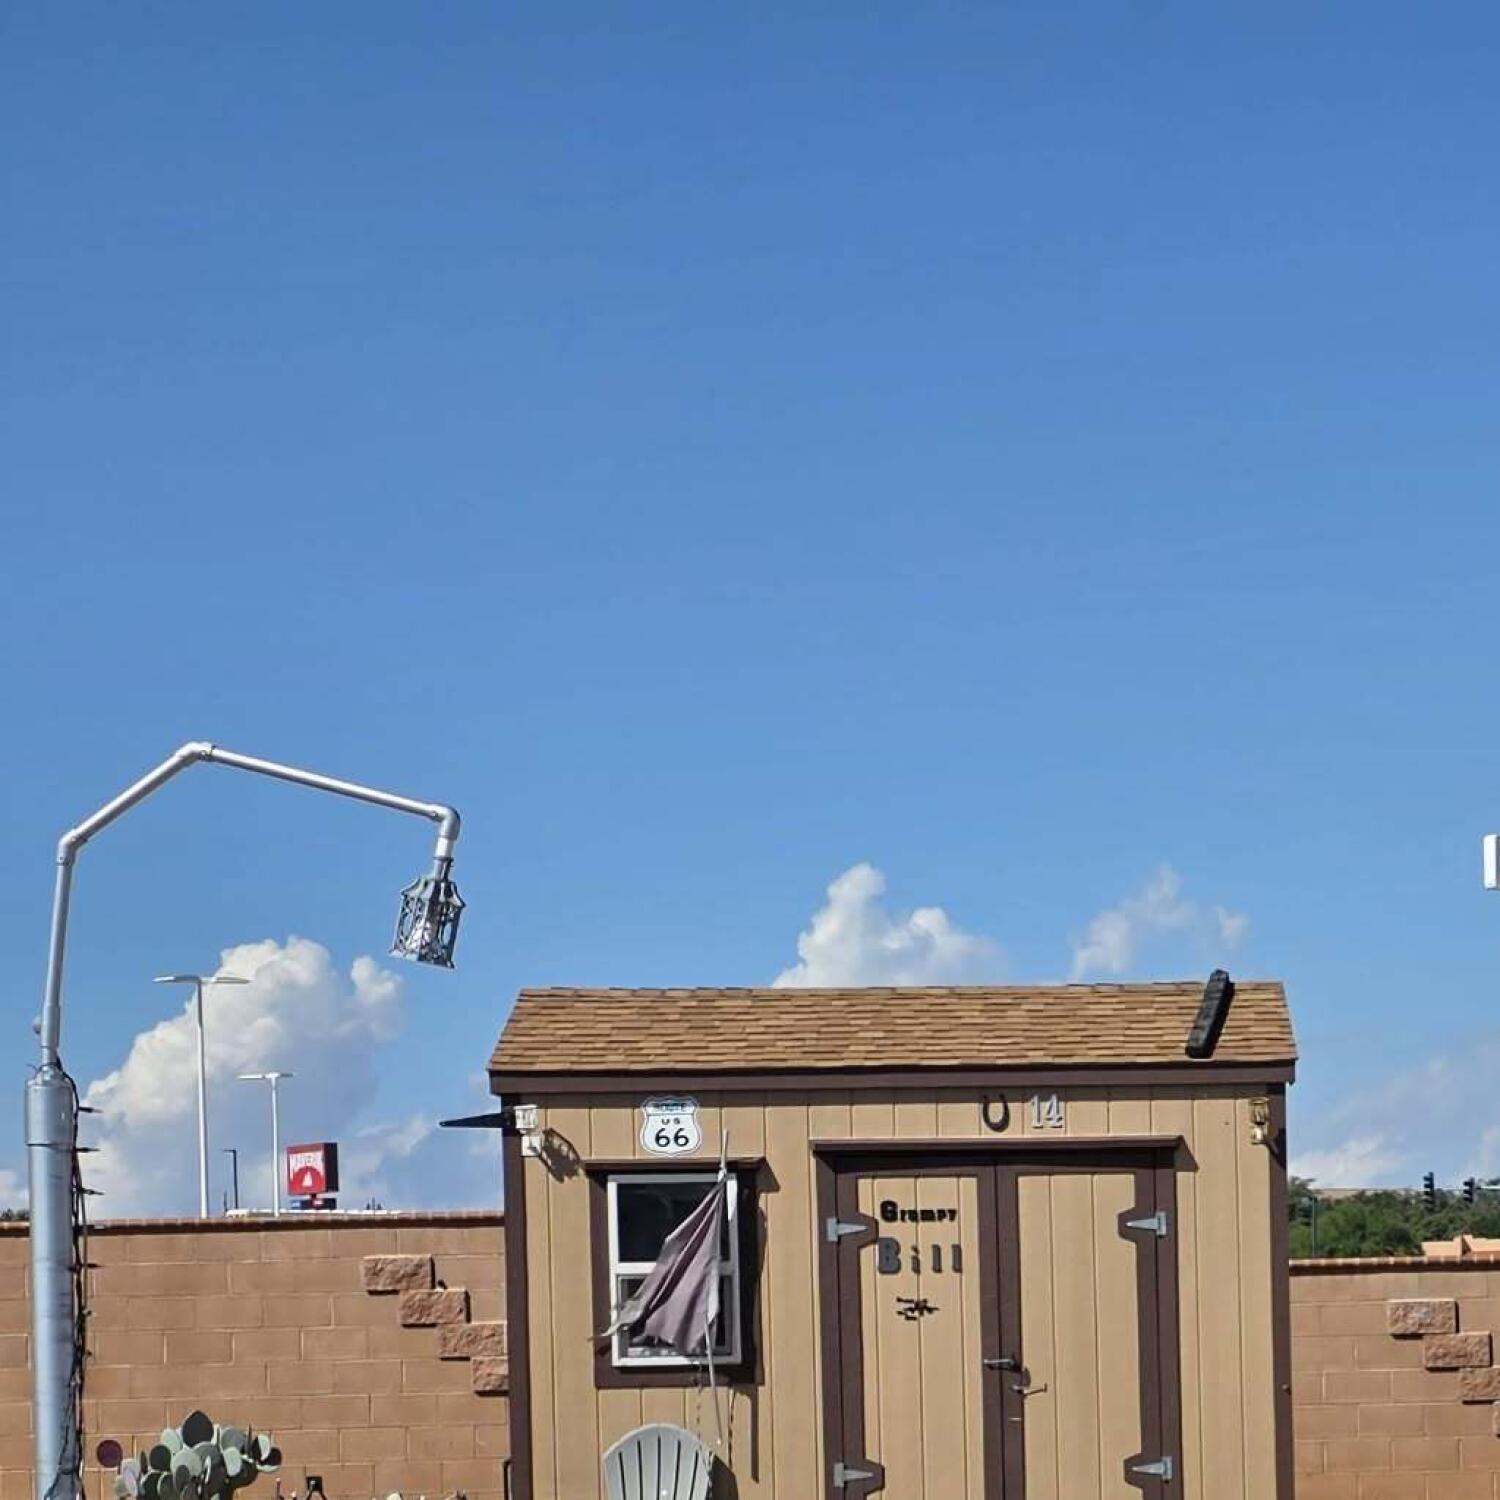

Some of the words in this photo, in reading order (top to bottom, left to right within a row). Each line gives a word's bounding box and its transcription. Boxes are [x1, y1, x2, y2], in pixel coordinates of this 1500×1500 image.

[1031, 1094, 1064, 1129] 14
[655, 1127, 689, 1148] 66
[879, 1237, 962, 1275] Bill
